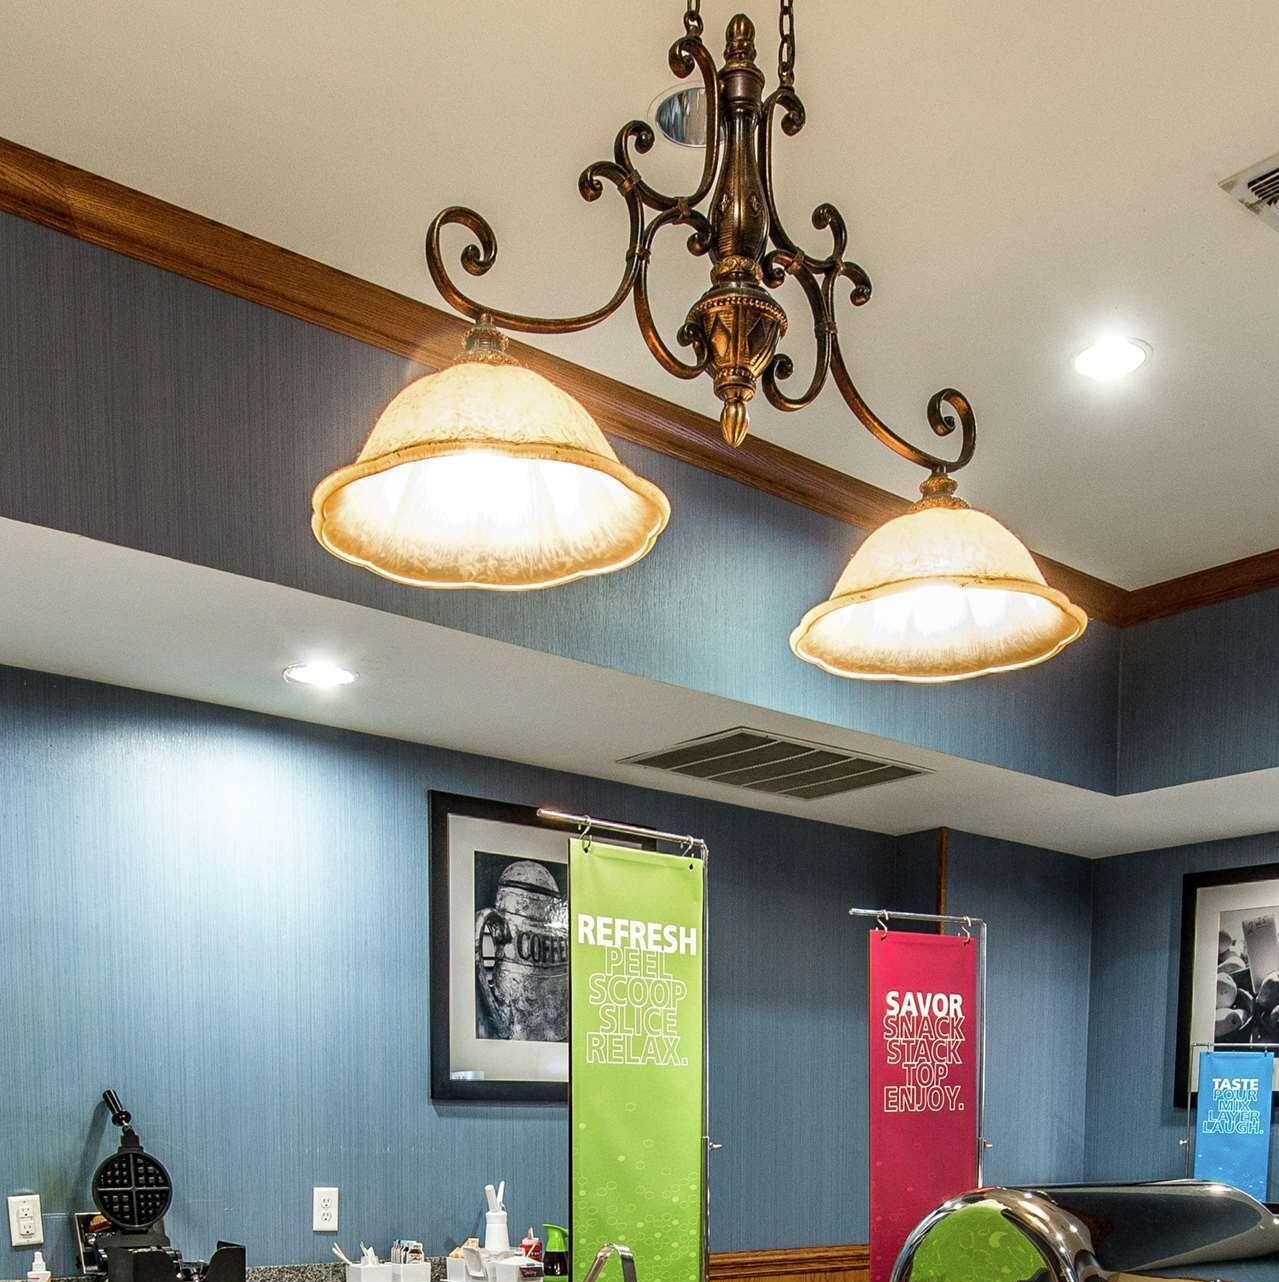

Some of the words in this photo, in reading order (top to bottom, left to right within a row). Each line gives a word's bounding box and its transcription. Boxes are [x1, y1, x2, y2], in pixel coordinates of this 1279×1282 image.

[577, 914, 697, 956] REFRESH
[605, 946, 673, 979] PEEL
[588, 973, 687, 1009] SCOOP
[885, 991, 963, 1017] SAVOR
[598, 1003, 678, 1037] SLICE
[883, 1015, 965, 1041] SNACK
[586, 1032, 689, 1066] RELAX.
[886, 1038, 962, 1064] STACK
[902, 1062, 949, 1088] TOP
[1212, 1078, 1259, 1091] TASTE
[884, 1085, 964, 1112] ENJOY.
[1213, 1089, 1257, 1102] POUR
[1218, 1099, 1251, 1111] MIX
[1202, 1120, 1264, 1135] LAUGH.
[1208, 1110, 1260, 1123] LAYER
